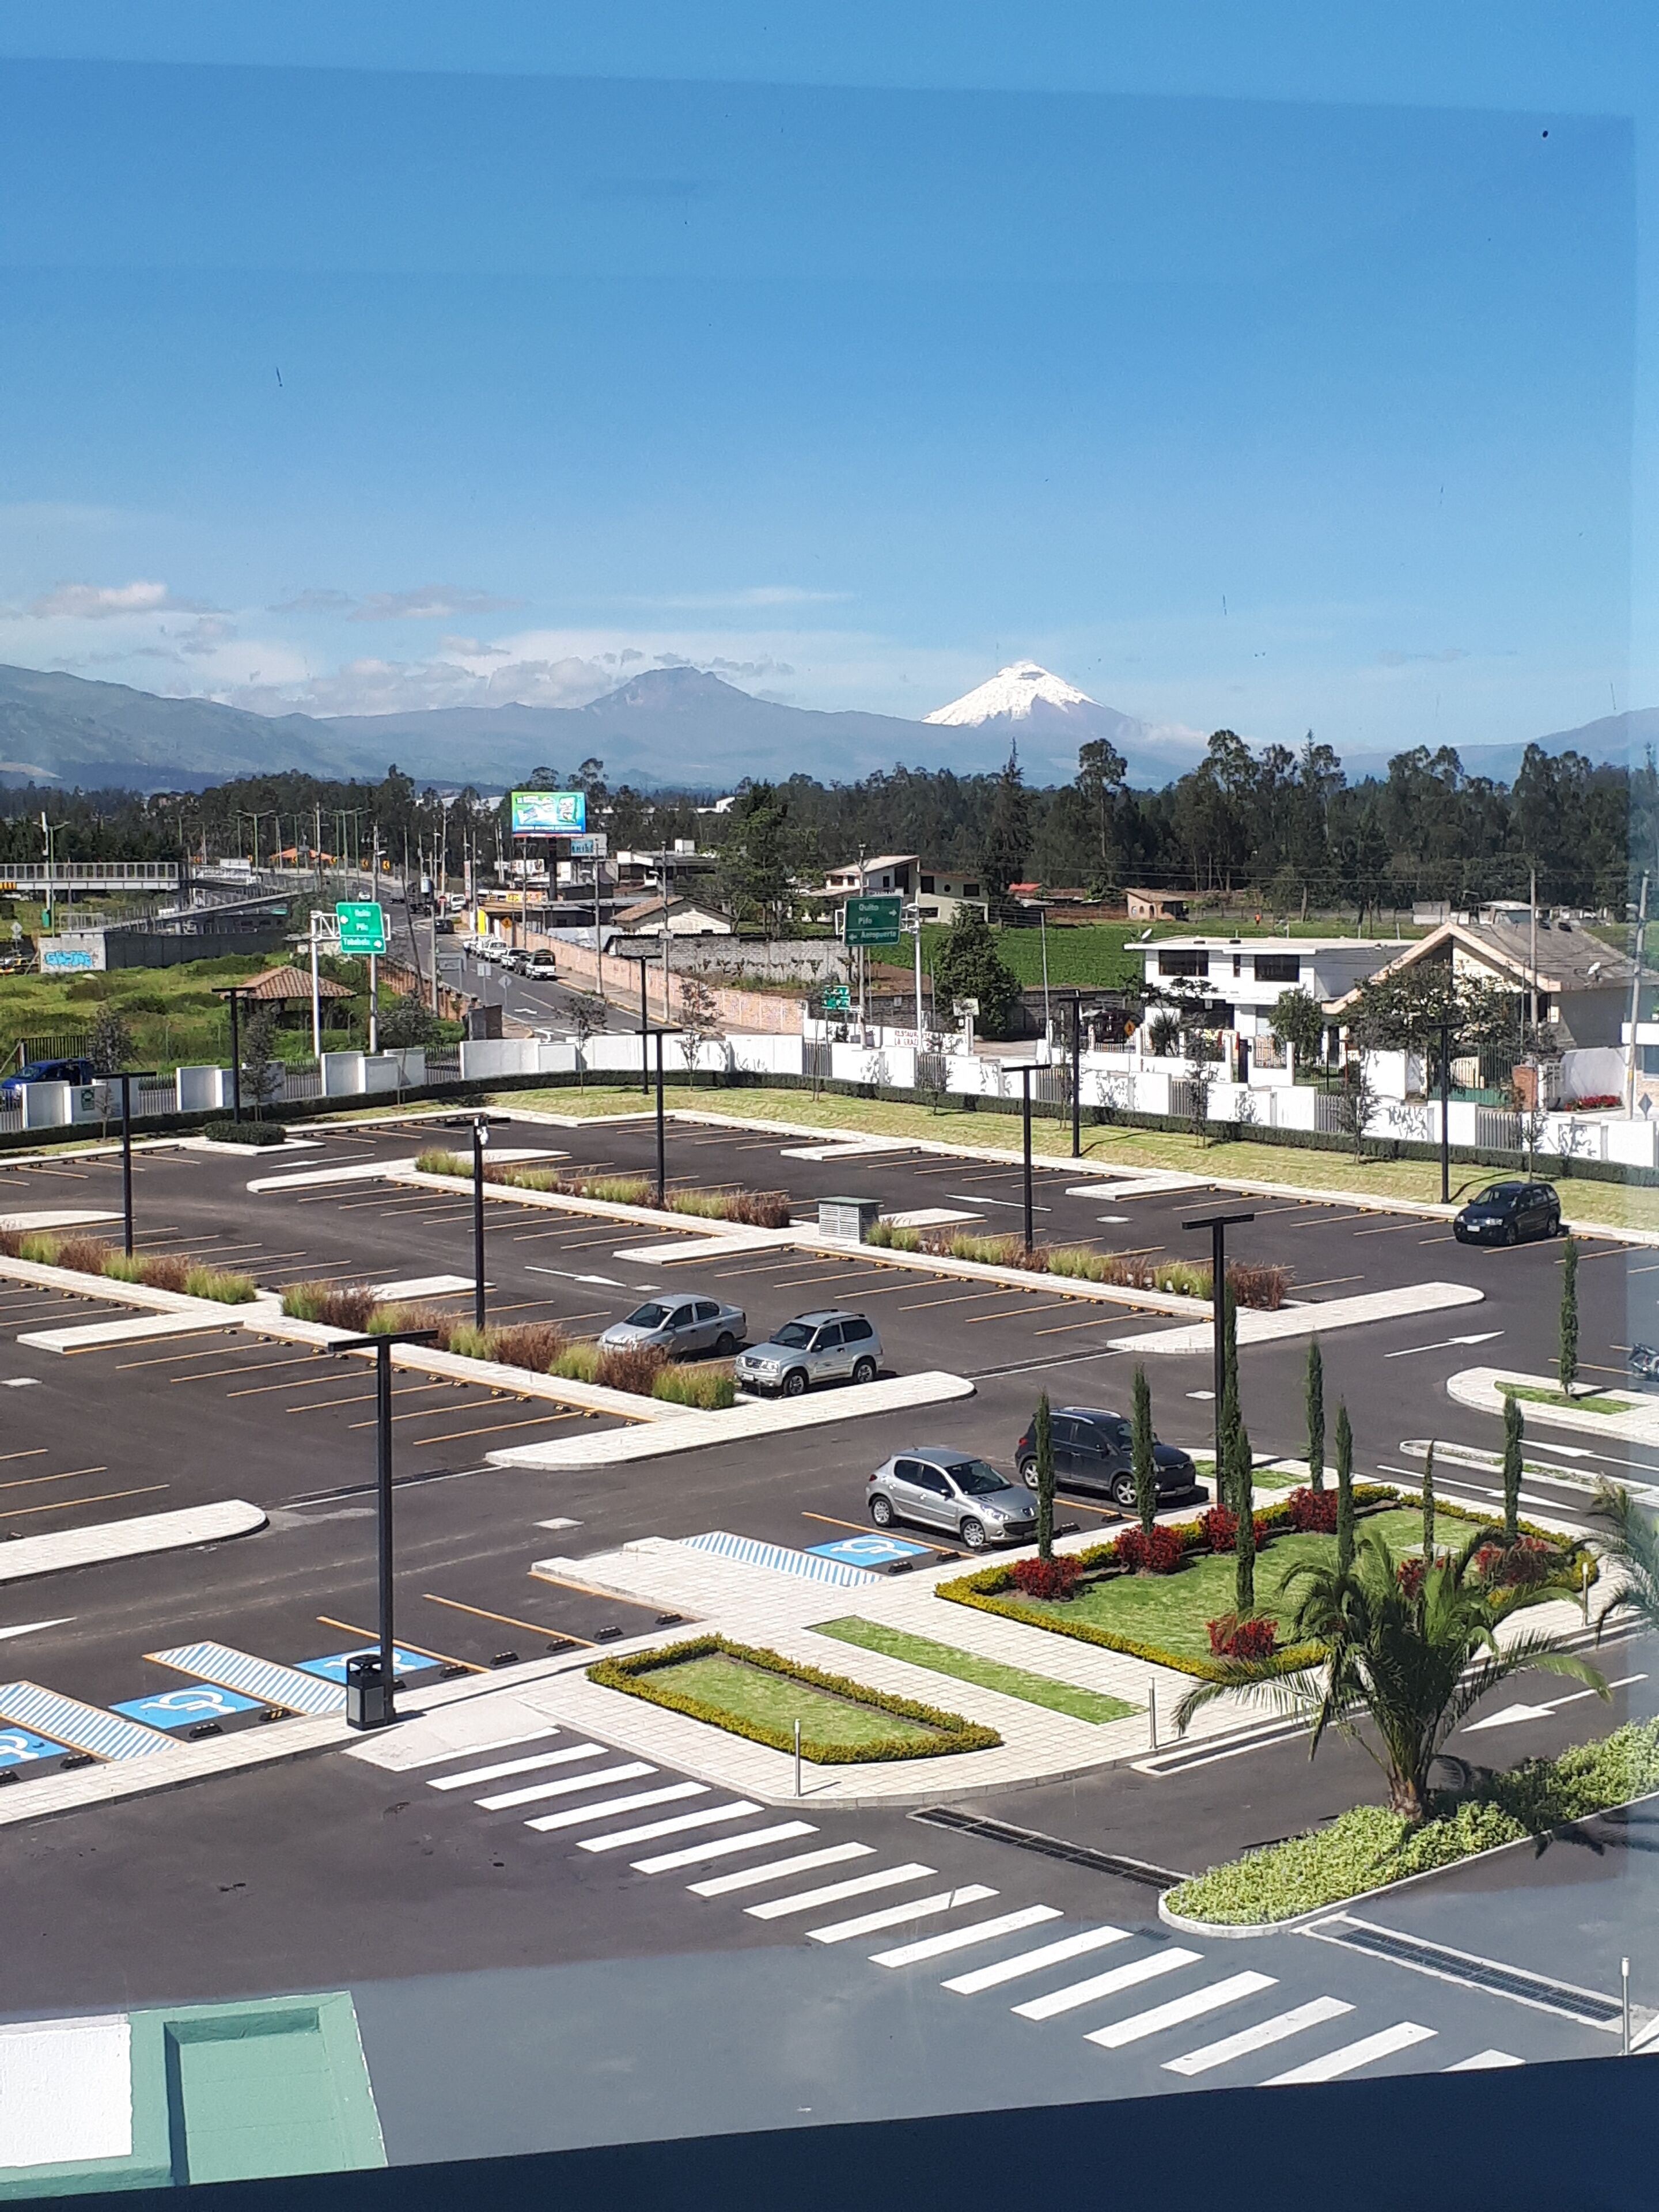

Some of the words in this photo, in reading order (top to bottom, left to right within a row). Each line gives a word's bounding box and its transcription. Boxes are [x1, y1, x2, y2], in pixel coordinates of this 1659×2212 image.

[858, 903, 879, 911] Quito
[858, 916, 873, 925] Pifo
[861, 930, 896, 939] Aeropuerto
